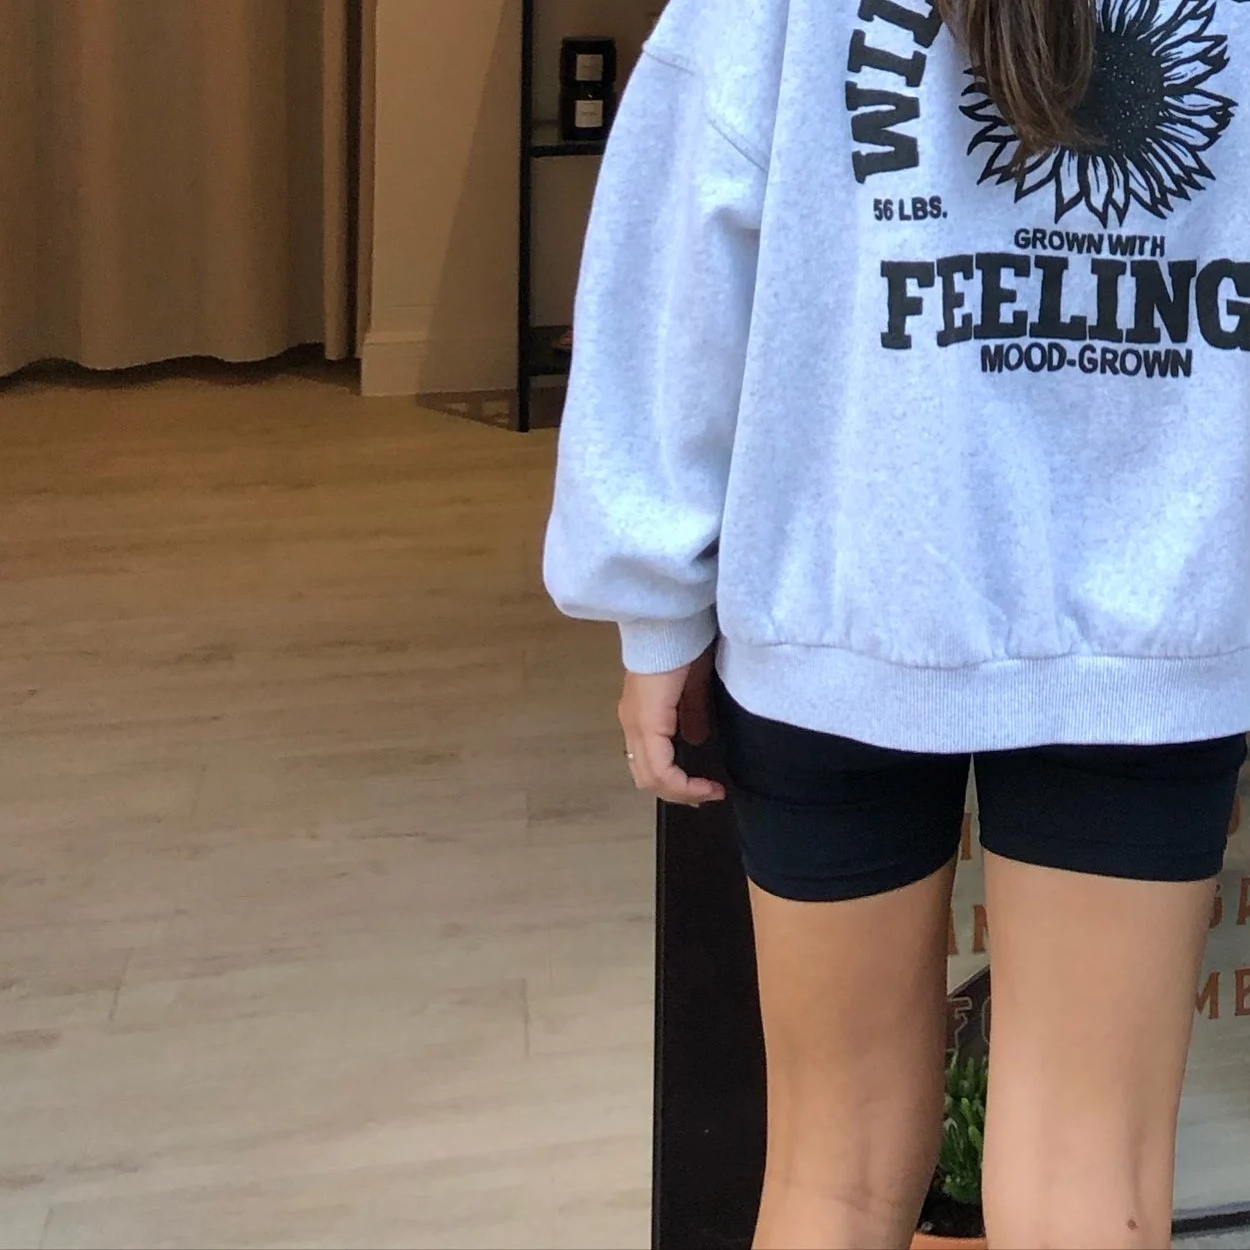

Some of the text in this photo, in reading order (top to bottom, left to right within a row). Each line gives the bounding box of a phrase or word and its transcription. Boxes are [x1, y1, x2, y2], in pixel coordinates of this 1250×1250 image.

[873, 196, 948, 222] 56 LBS.
[1013, 228, 1166, 257] GROWN WITH
[980, 344, 1193, 378] MOOD-GROWN
